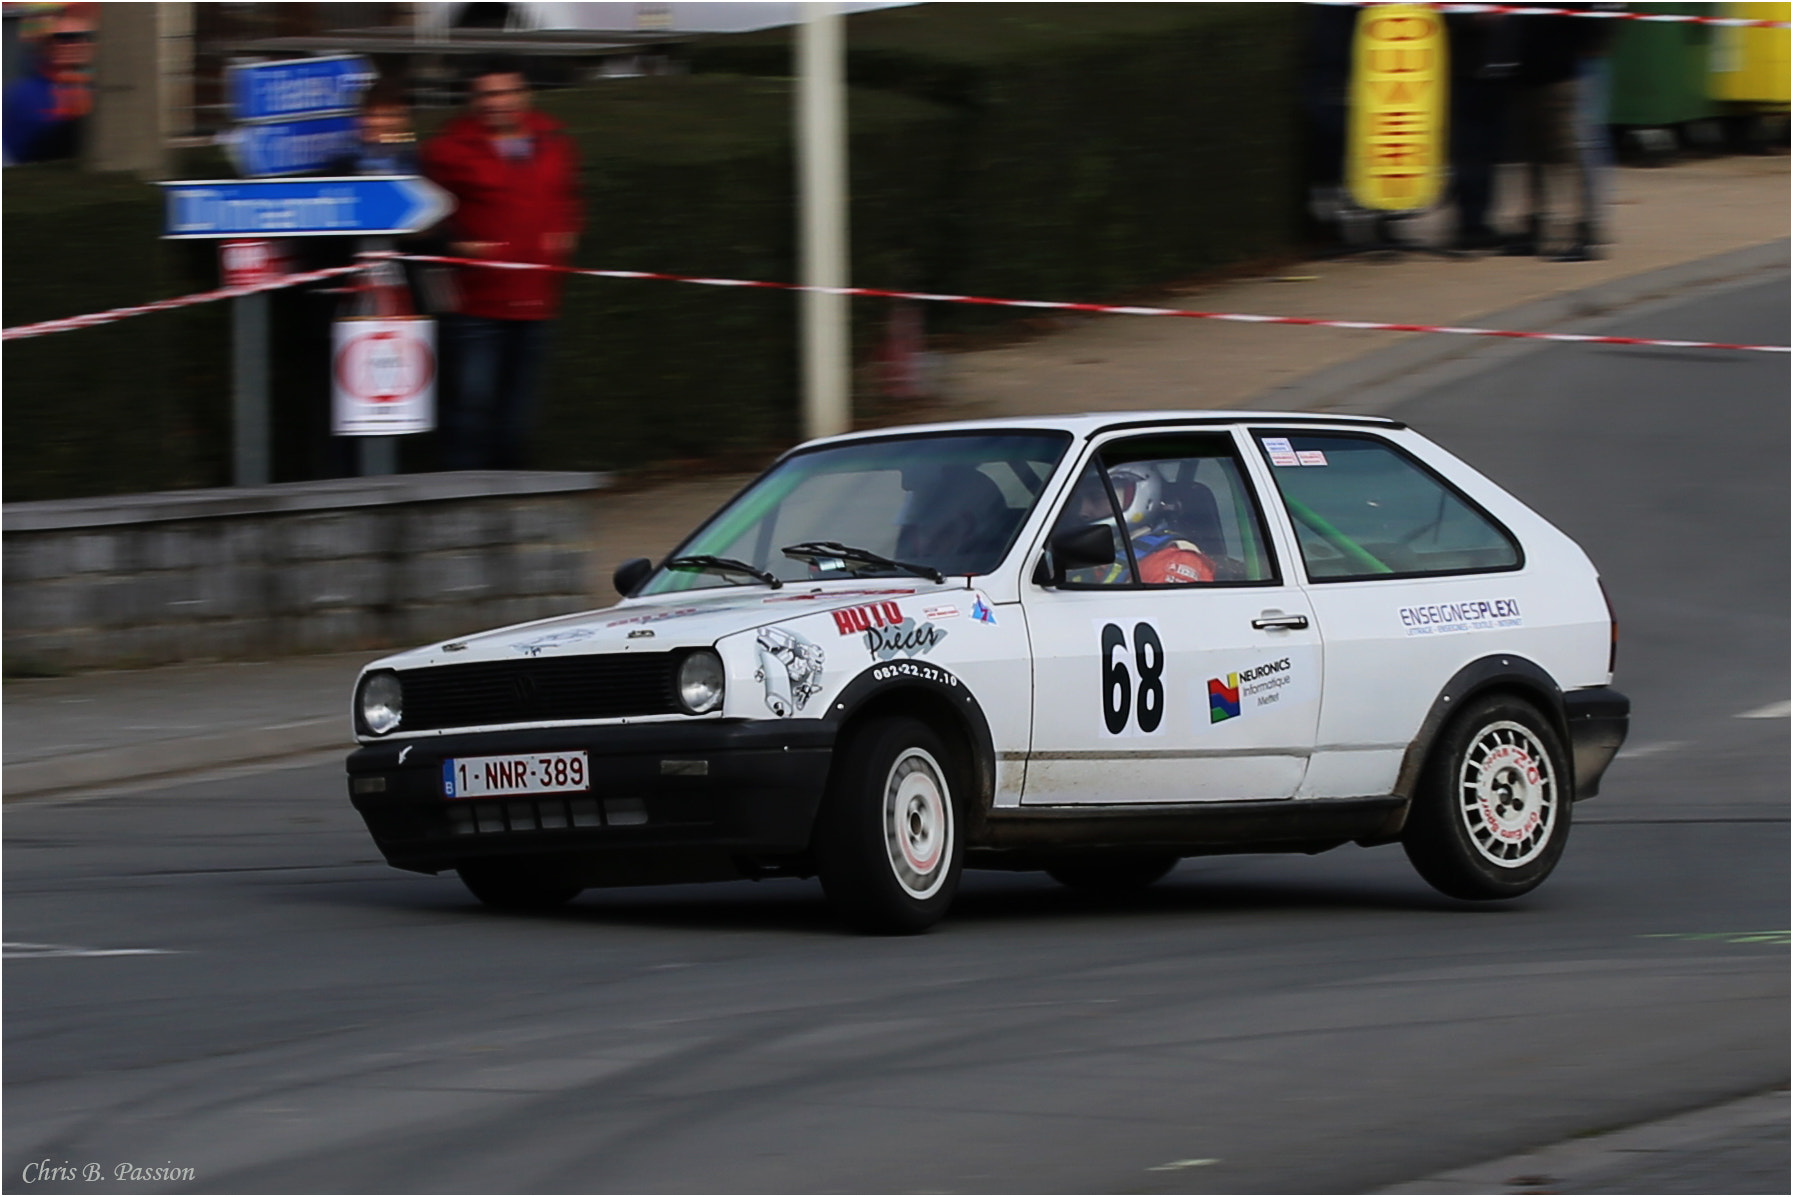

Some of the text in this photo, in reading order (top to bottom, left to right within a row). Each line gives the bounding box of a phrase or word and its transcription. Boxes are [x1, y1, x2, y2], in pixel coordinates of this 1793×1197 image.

[831, 601, 903, 634] AUTO
[1400, 599, 1520, 626] ENSEIGNESPLEXI
[866, 626, 938, 661] Pièces
[1102, 622, 1163, 734] 68
[1239, 658, 1290, 683] NEURONICS
[1243, 675, 1290, 697] Informatique
[445, 781, 453, 795] B
